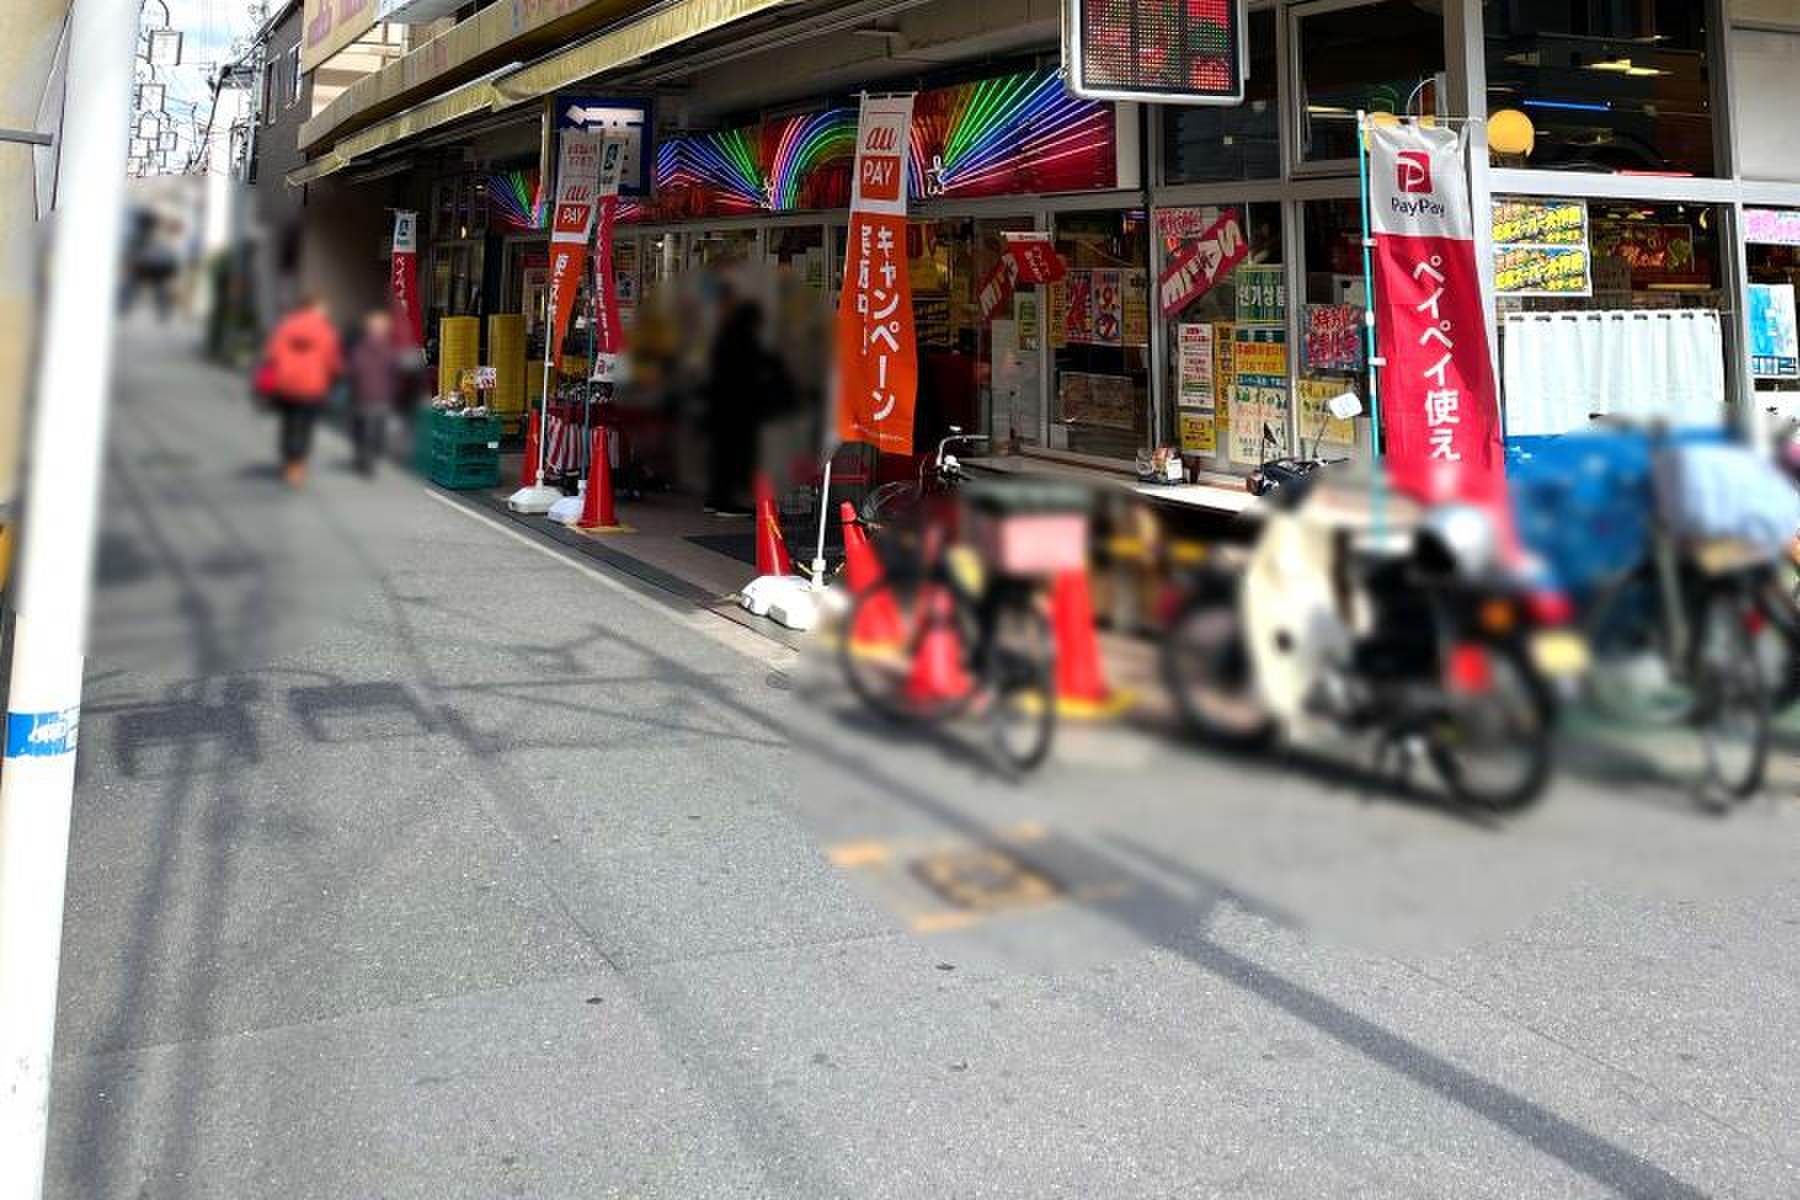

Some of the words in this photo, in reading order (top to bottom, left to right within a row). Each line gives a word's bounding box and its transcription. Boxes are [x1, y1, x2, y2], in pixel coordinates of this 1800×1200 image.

[865, 126, 897, 150] au
[863, 159, 894, 186] PAY
[1391, 196, 1445, 218] PayPay
[871, 224, 900, 422] キャンペーン
[1412, 255, 1461, 492] ペイペイ使え
